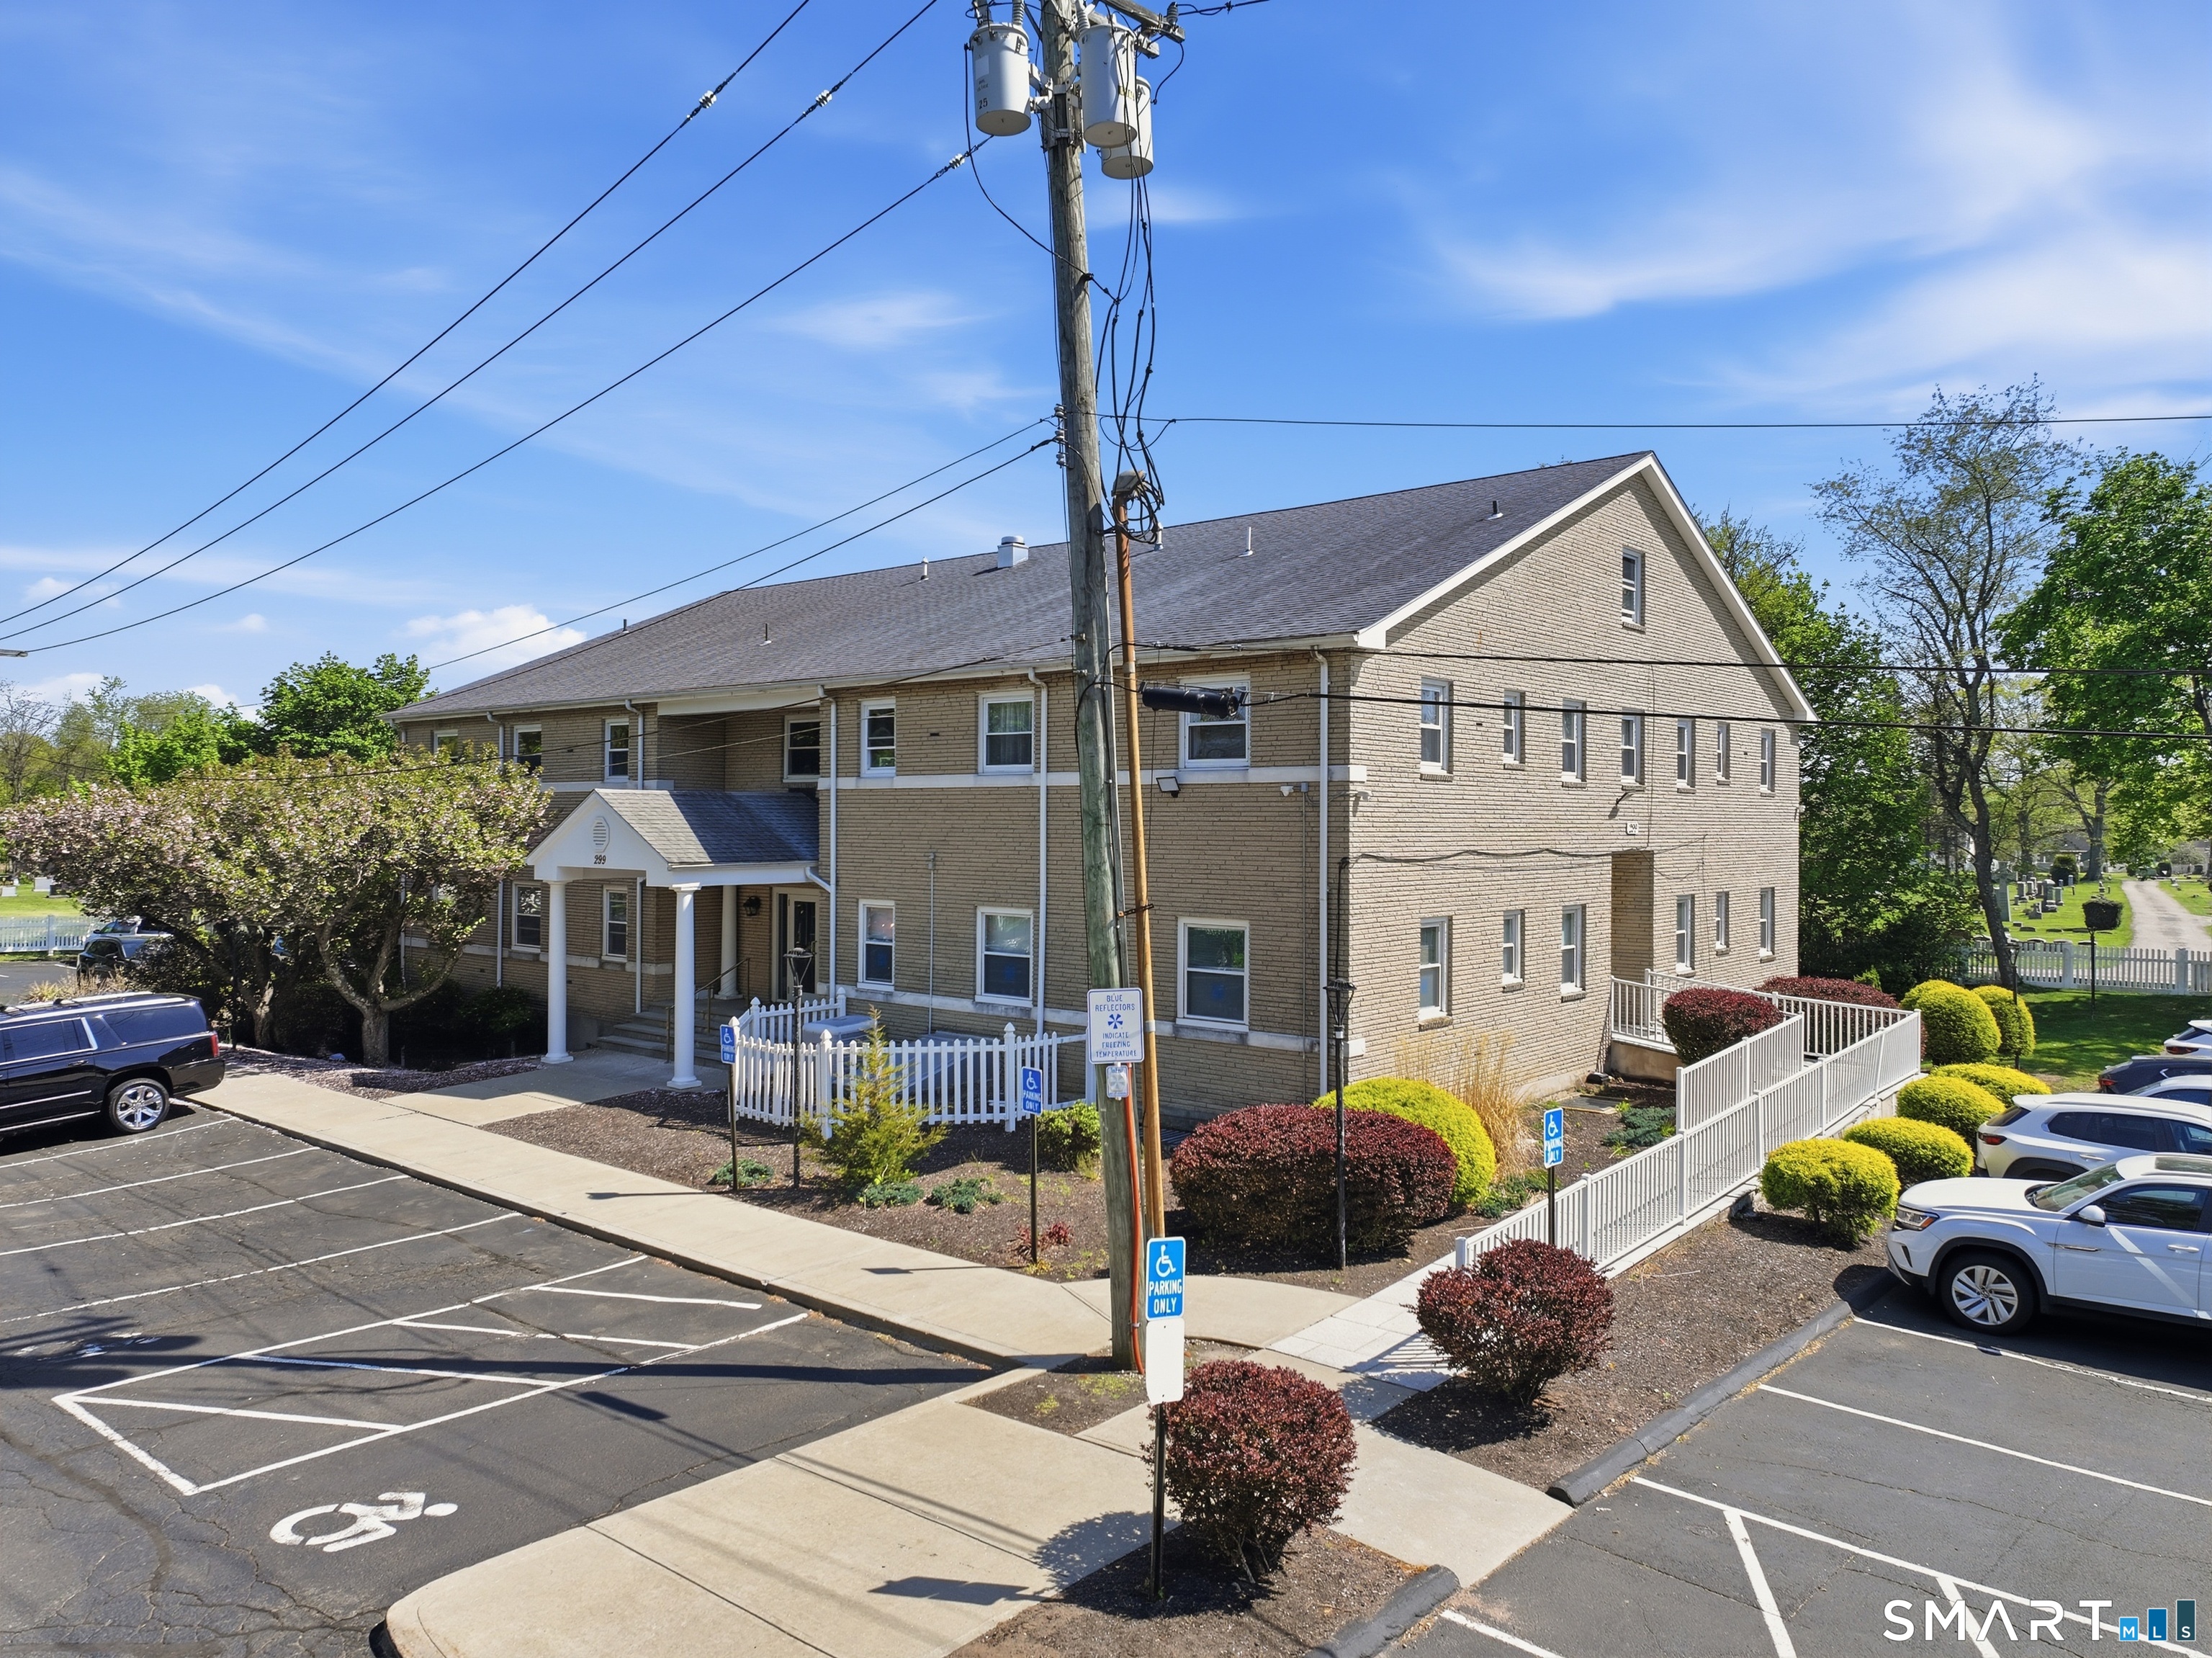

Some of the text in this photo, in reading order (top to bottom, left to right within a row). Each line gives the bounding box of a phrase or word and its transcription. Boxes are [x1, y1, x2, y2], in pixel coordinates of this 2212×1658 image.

[593, 854, 606, 865] 299
[1095, 1003, 1136, 1012] REFLECTORS
[1096, 1049, 1136, 1058] TEMPERATURE
[1023, 1090, 1041, 1103] PARKING
[1025, 1101, 1039, 1111] ONLY
[1148, 1278, 1182, 1296] PARKING
[1154, 1297, 1177, 1314] ONLY
